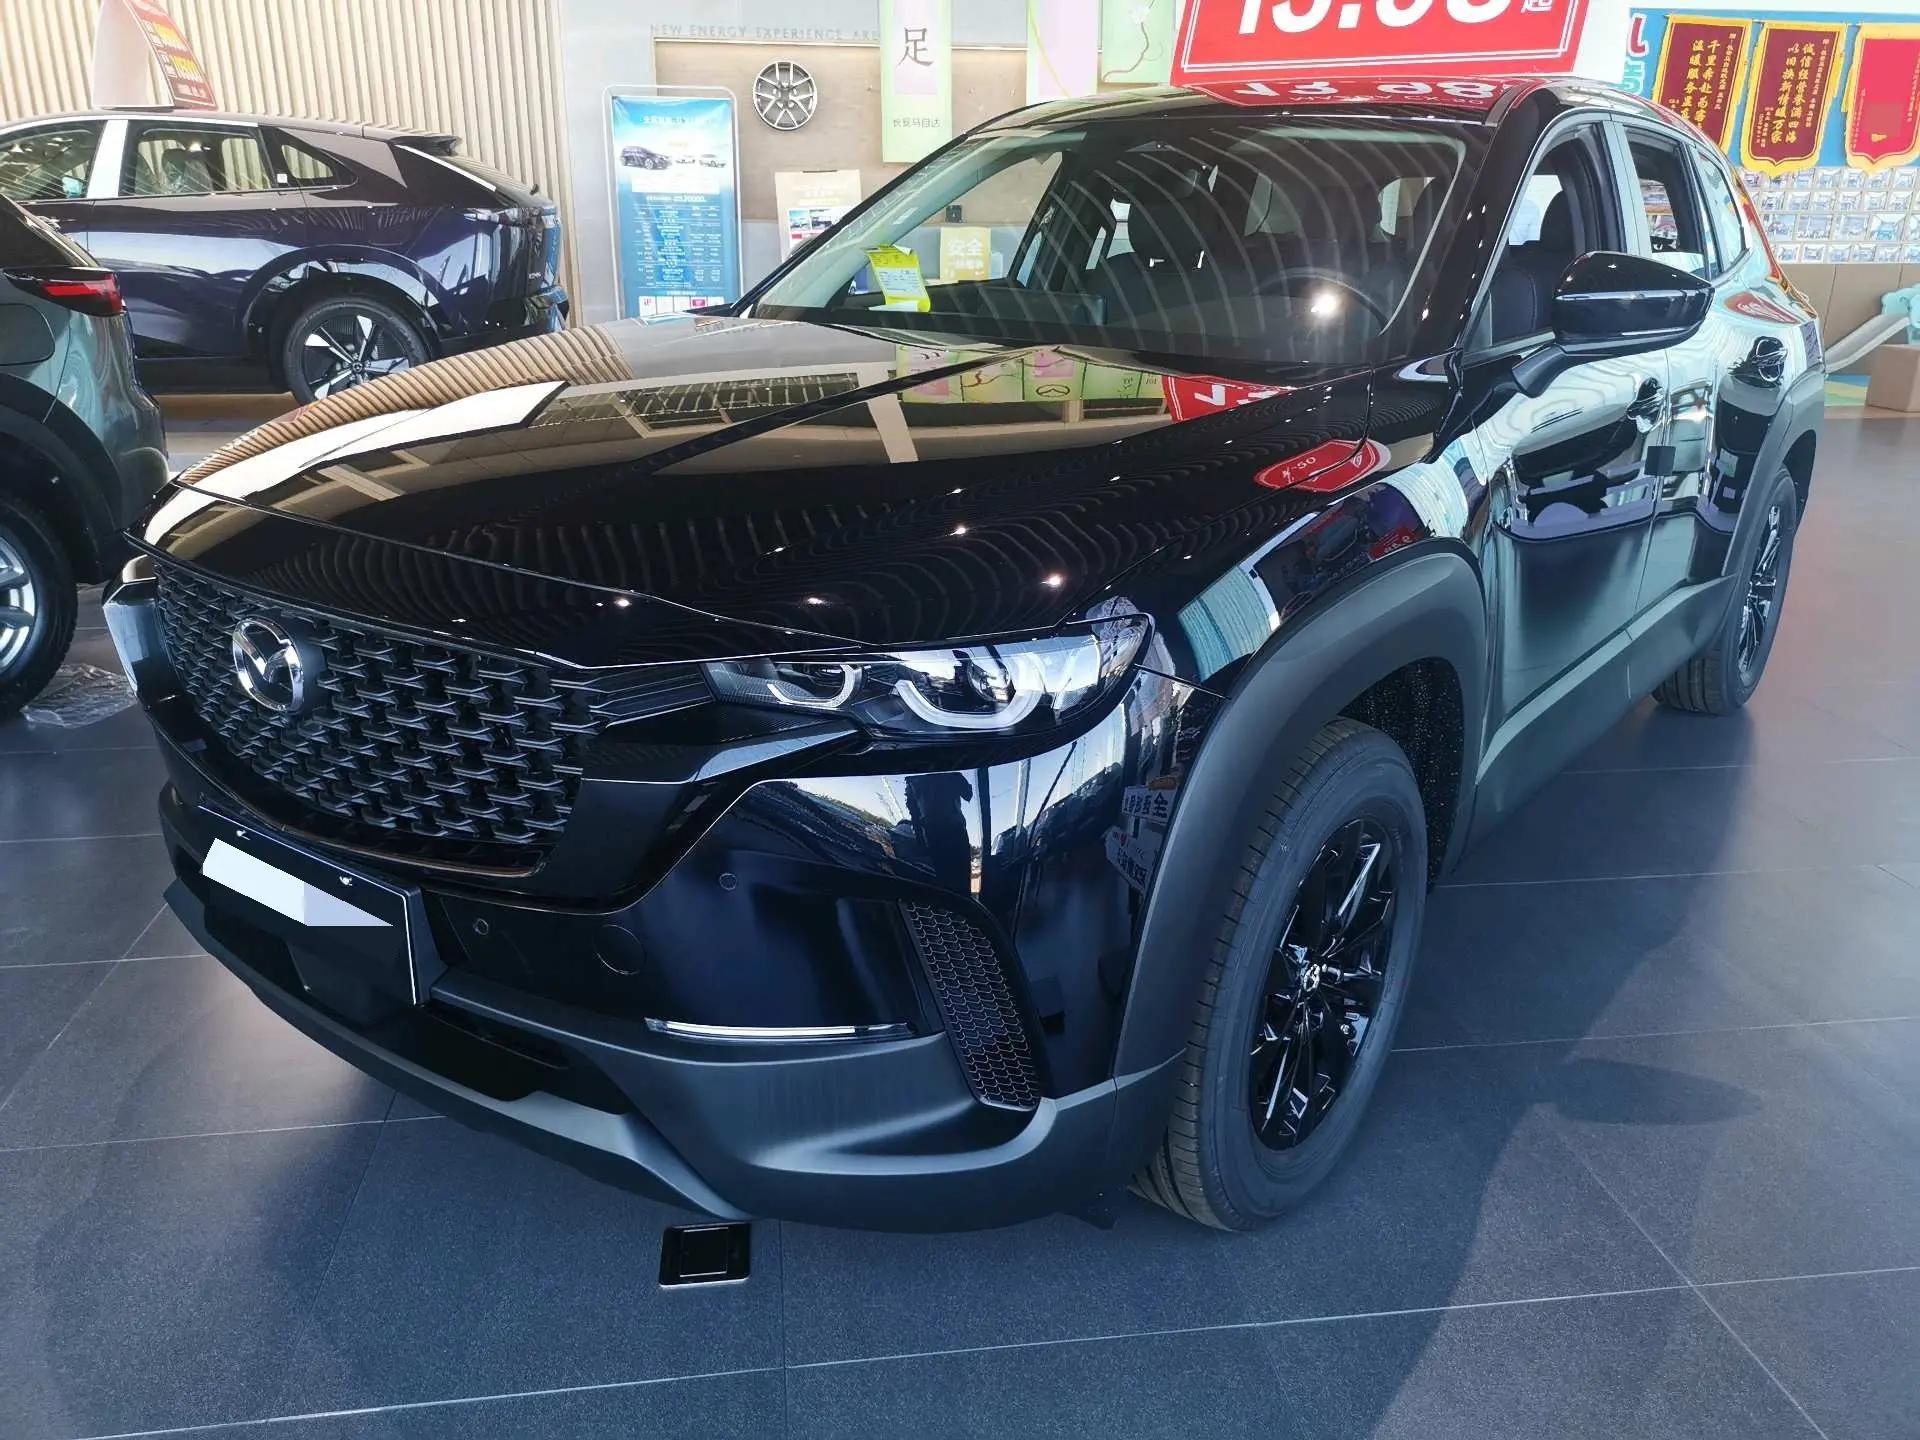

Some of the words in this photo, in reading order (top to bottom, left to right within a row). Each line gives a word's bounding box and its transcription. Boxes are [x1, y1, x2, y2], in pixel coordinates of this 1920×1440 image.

[650, 24, 682, 36] NEW
[690, 25, 747, 38] ENERGY
[756, 27, 841, 40] EXPERIENCE
[853, 30, 880, 40] ARE
[897, 27, 935, 67] 足
